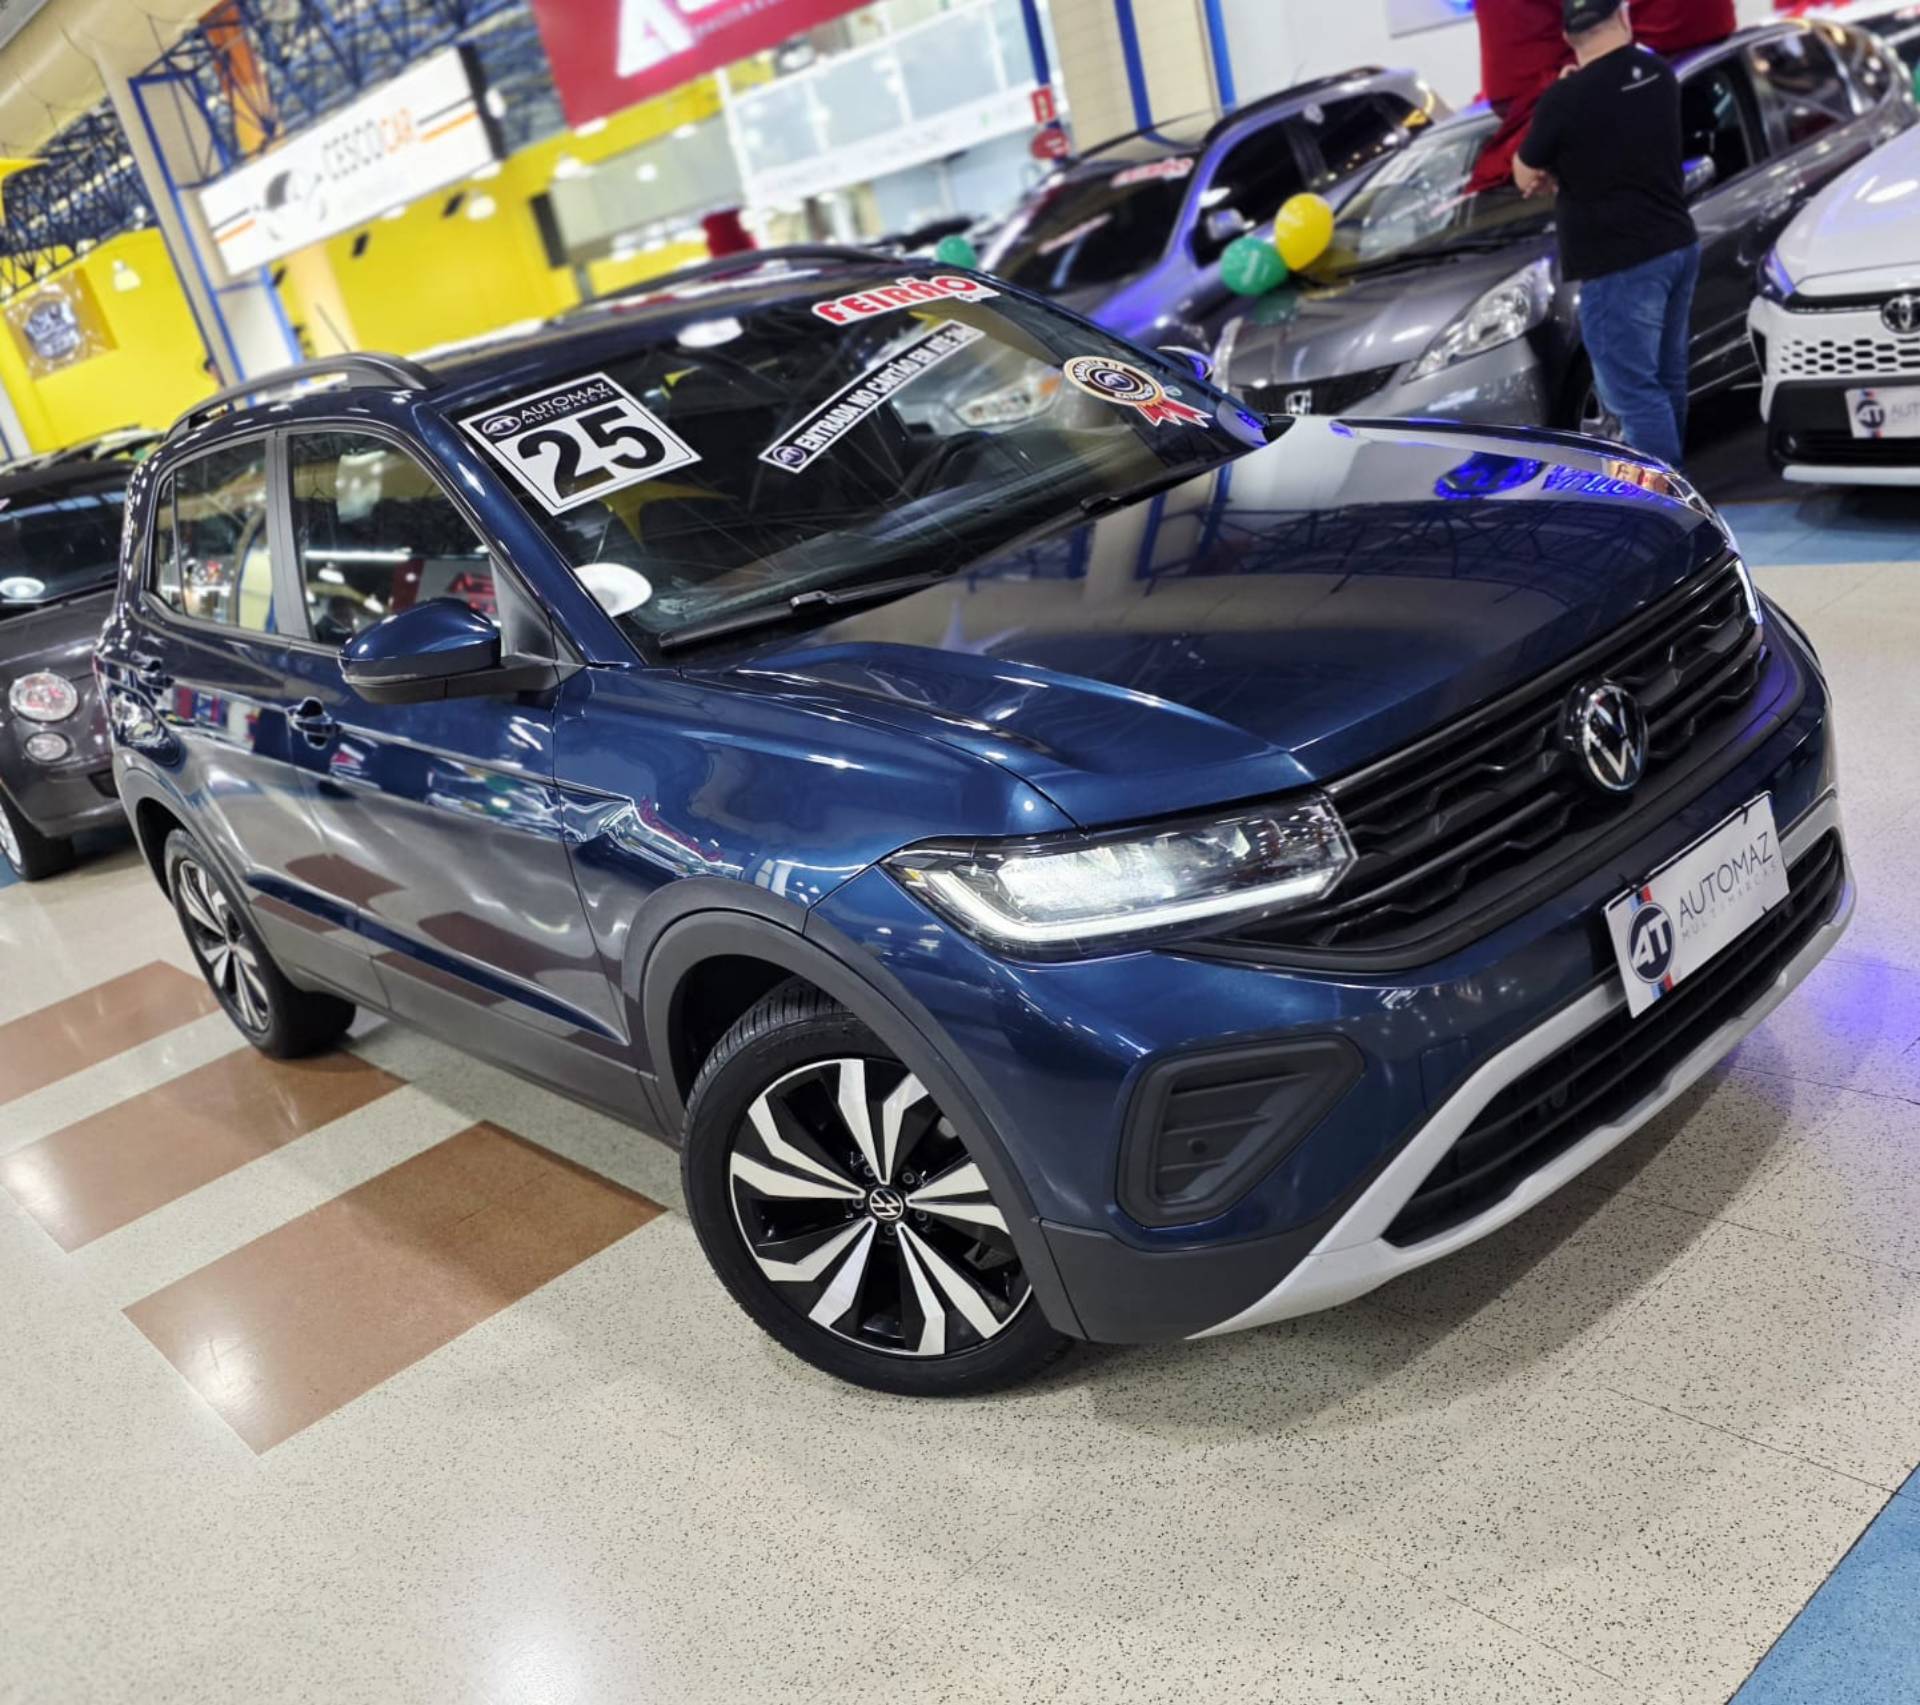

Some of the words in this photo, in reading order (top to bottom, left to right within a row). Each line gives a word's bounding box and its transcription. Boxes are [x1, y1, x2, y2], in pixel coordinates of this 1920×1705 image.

[816, 277, 978, 322] FEIRÃO
[520, 382, 610, 420] AUTOMAZ
[524, 389, 614, 425] MULTIMARCAS
[794, 403, 862, 452] ENTRADA
[847, 388, 879, 412] NO
[866, 355, 921, 394] CARTÃO
[517, 404, 666, 499] 25
[1679, 831, 1774, 928] AUTOMAZ
